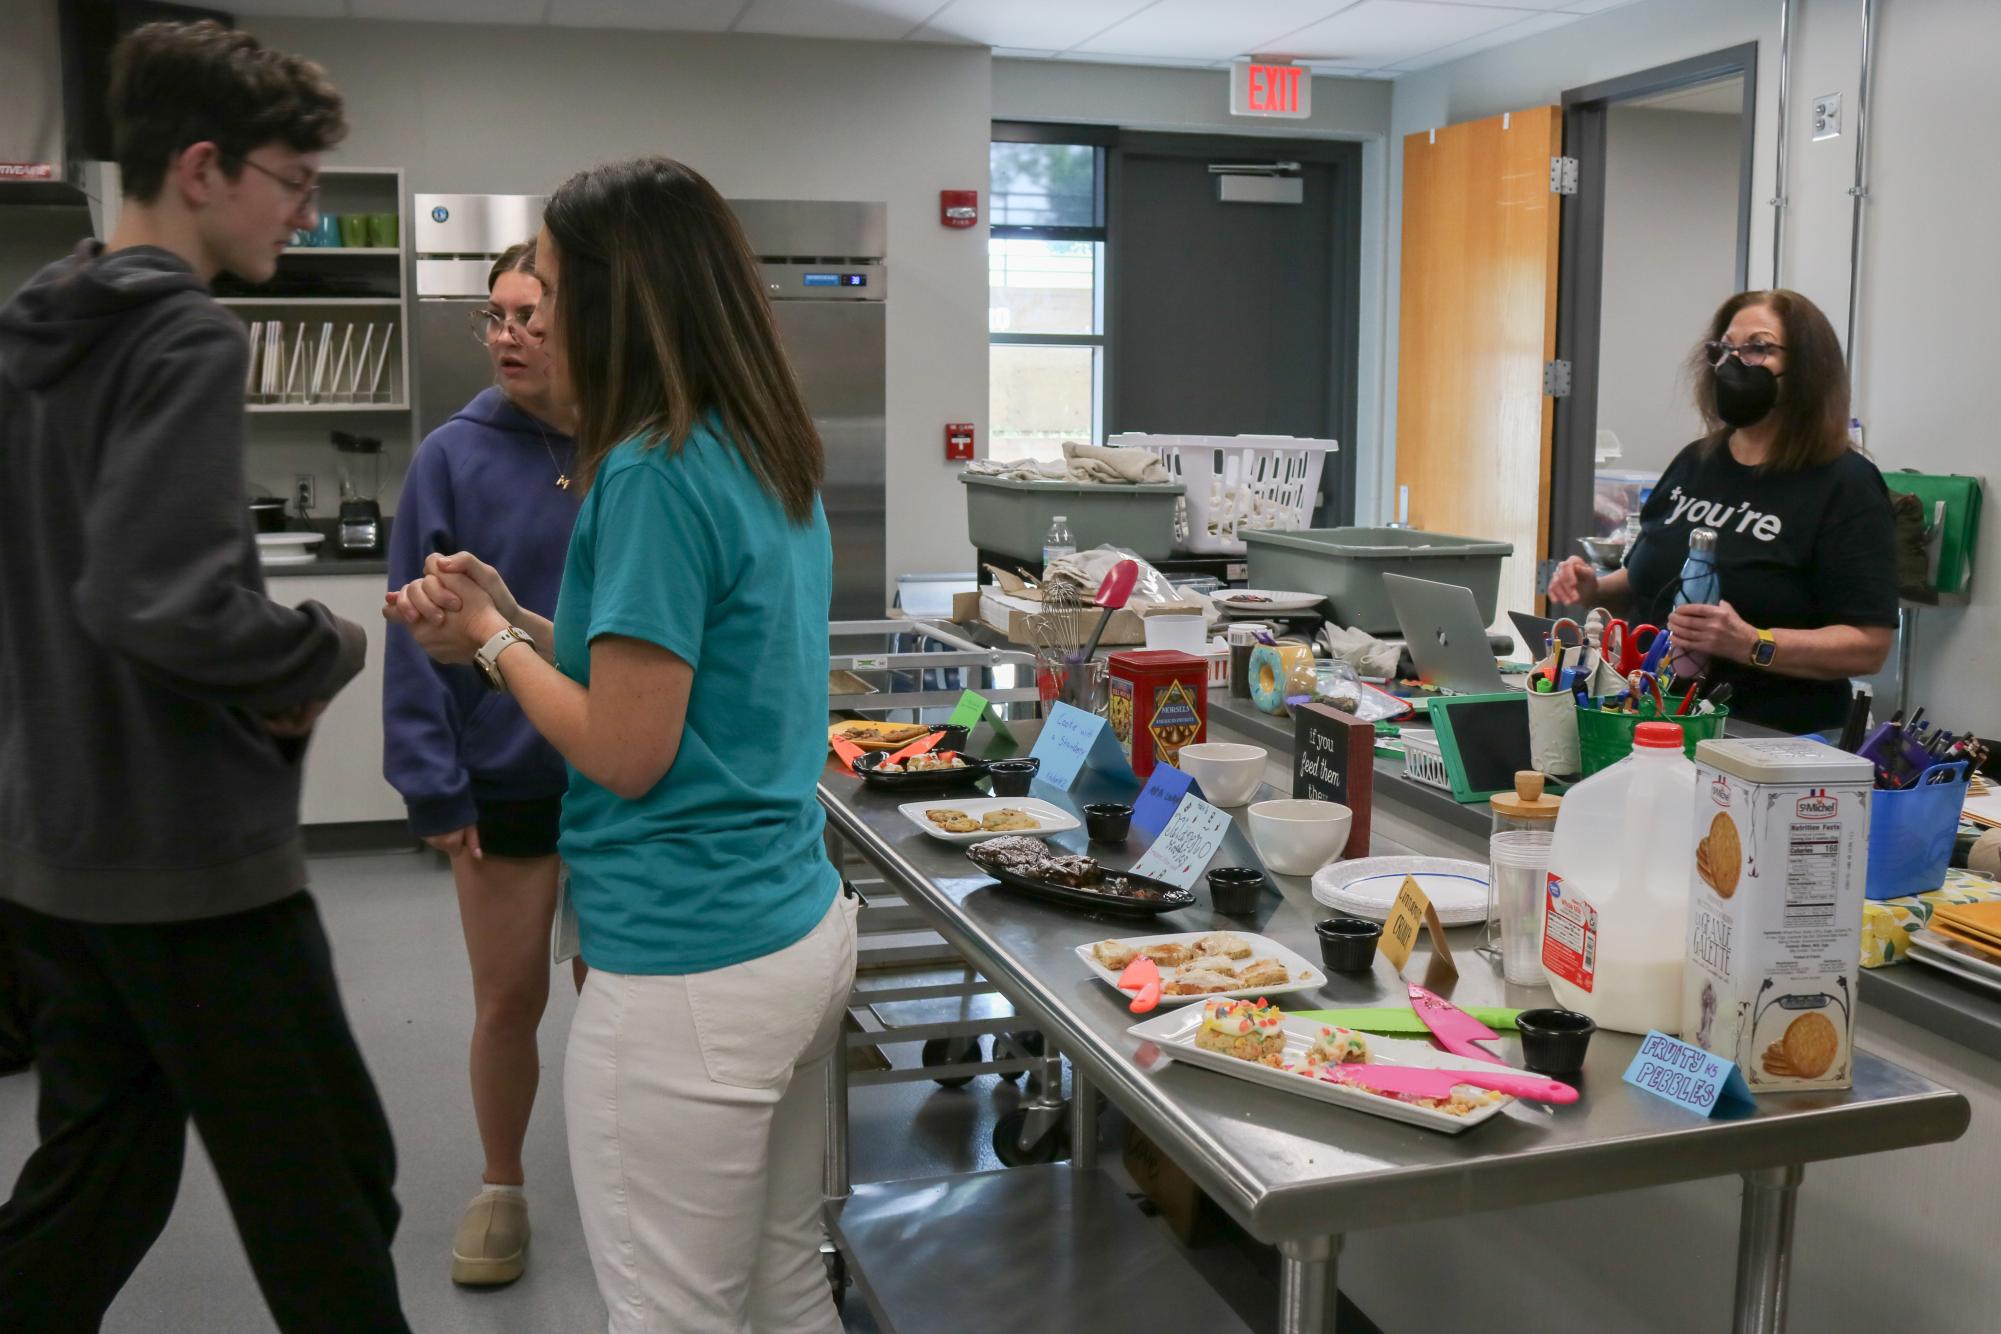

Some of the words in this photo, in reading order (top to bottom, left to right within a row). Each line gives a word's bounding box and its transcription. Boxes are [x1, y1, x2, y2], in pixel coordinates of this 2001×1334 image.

[1248, 64, 1303, 112] EXIT
[1309, 727, 1318, 745] if
[1316, 733, 1335, 753] you
[1300, 751, 1320, 777] feed
[1320, 757, 1341, 787] them
[1791, 824, 1820, 832] Nutrition
[1822, 823, 1840, 831] Facts
[1824, 844, 1838, 852] 160
[1642, 1035, 1706, 1073] FRUITY
[1635, 1062, 1715, 1108] PEBBLES
